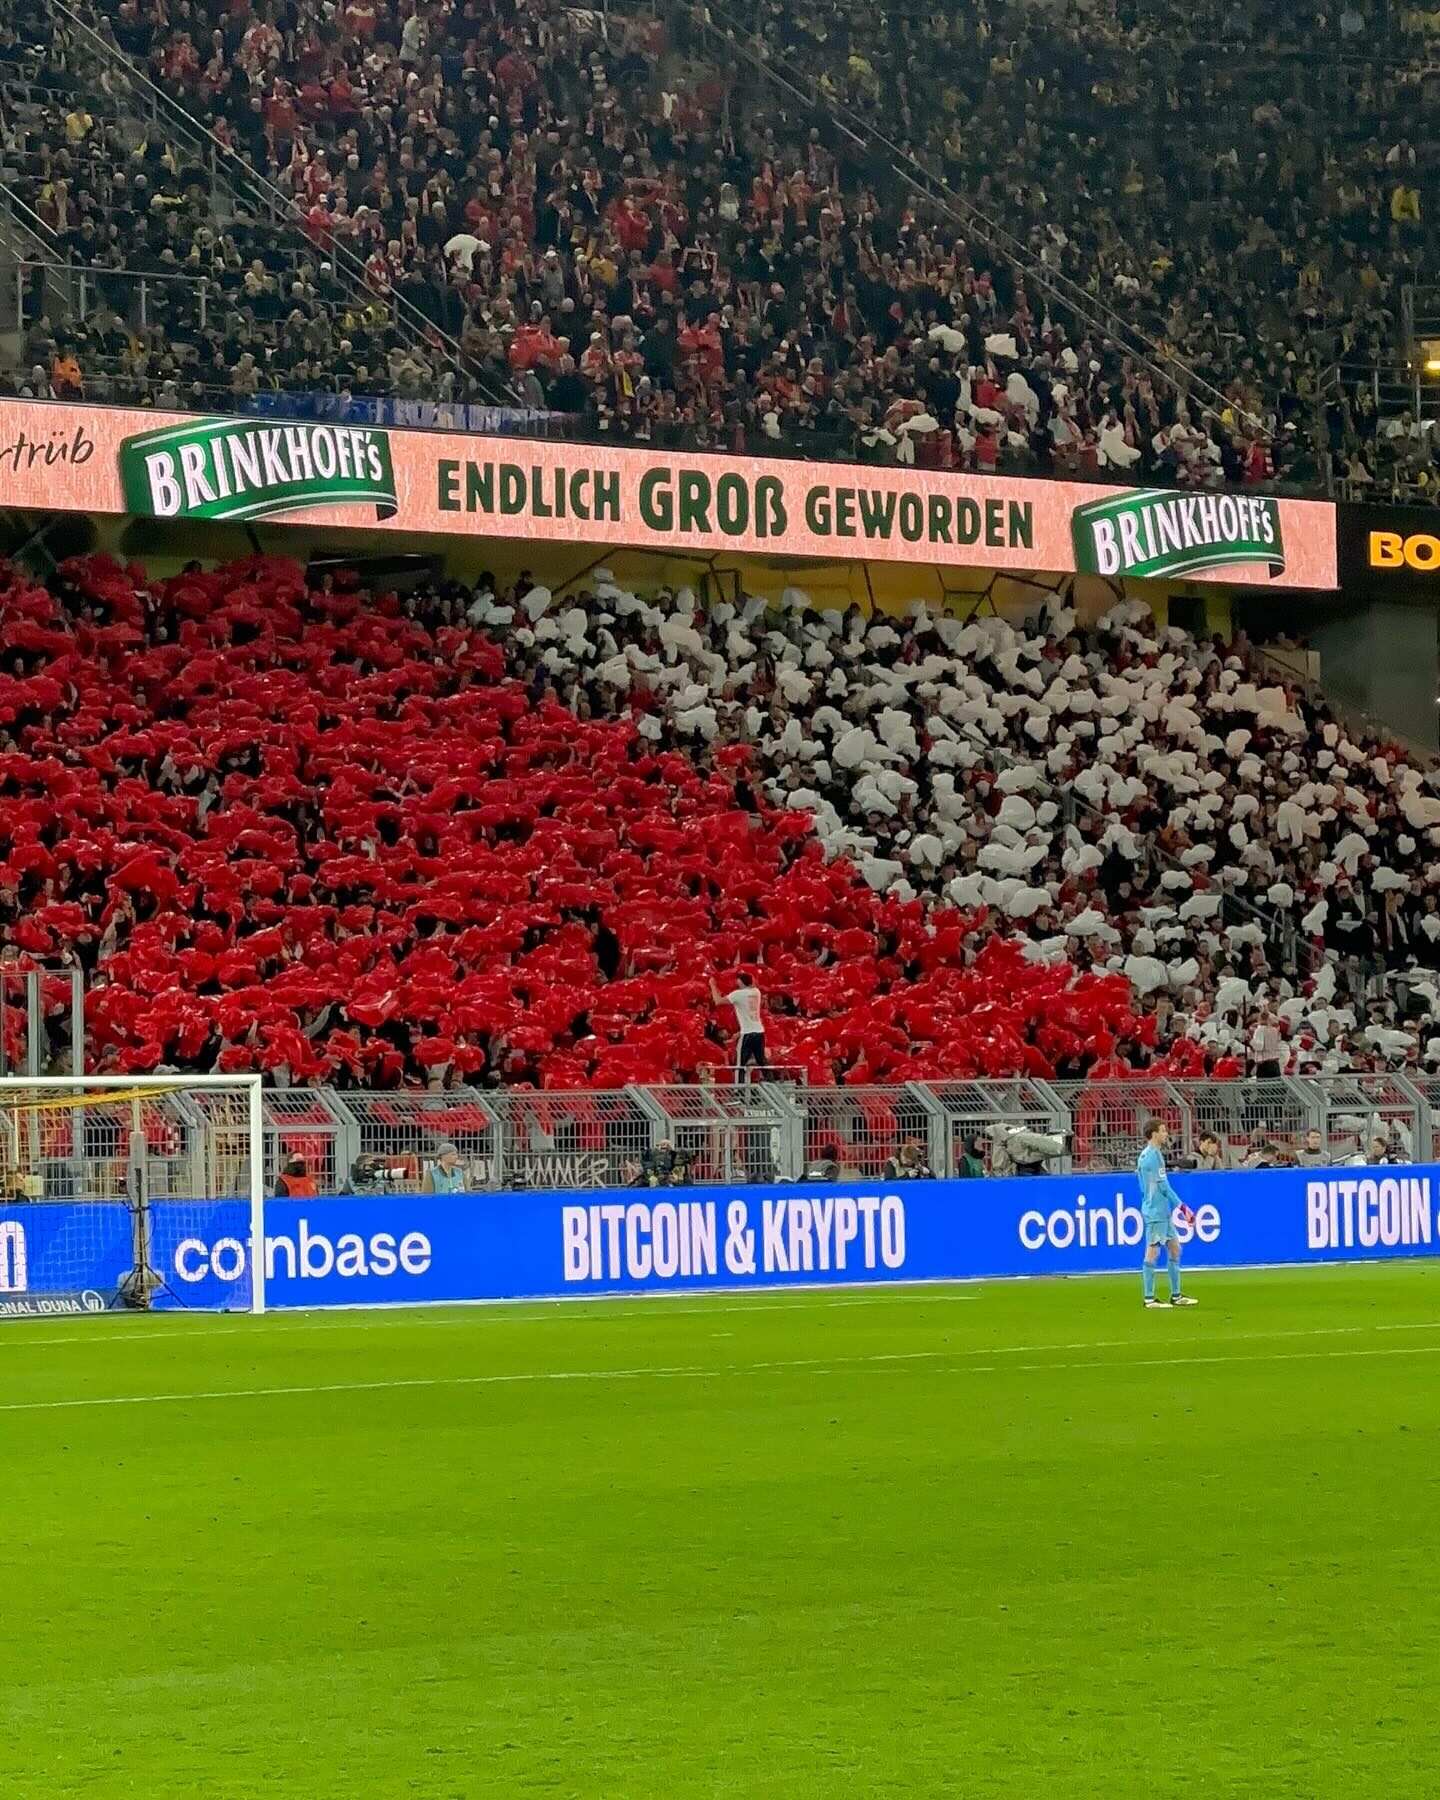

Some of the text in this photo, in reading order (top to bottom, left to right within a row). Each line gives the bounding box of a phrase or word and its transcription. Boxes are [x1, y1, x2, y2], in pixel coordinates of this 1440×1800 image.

[438, 460, 1033, 548] ENDLICH GROß GEWORDEN
[1370, 531, 1440, 570] BO
[563, 1195, 906, 1281] BITCOIN & KRYPTO
[1019, 1193, 1221, 1250] coinbse
[1307, 1178, 1432, 1249] BITCOIN
[174, 1219, 432, 1282] conbase
[37, 1299, 82, 1313] IDUNA
